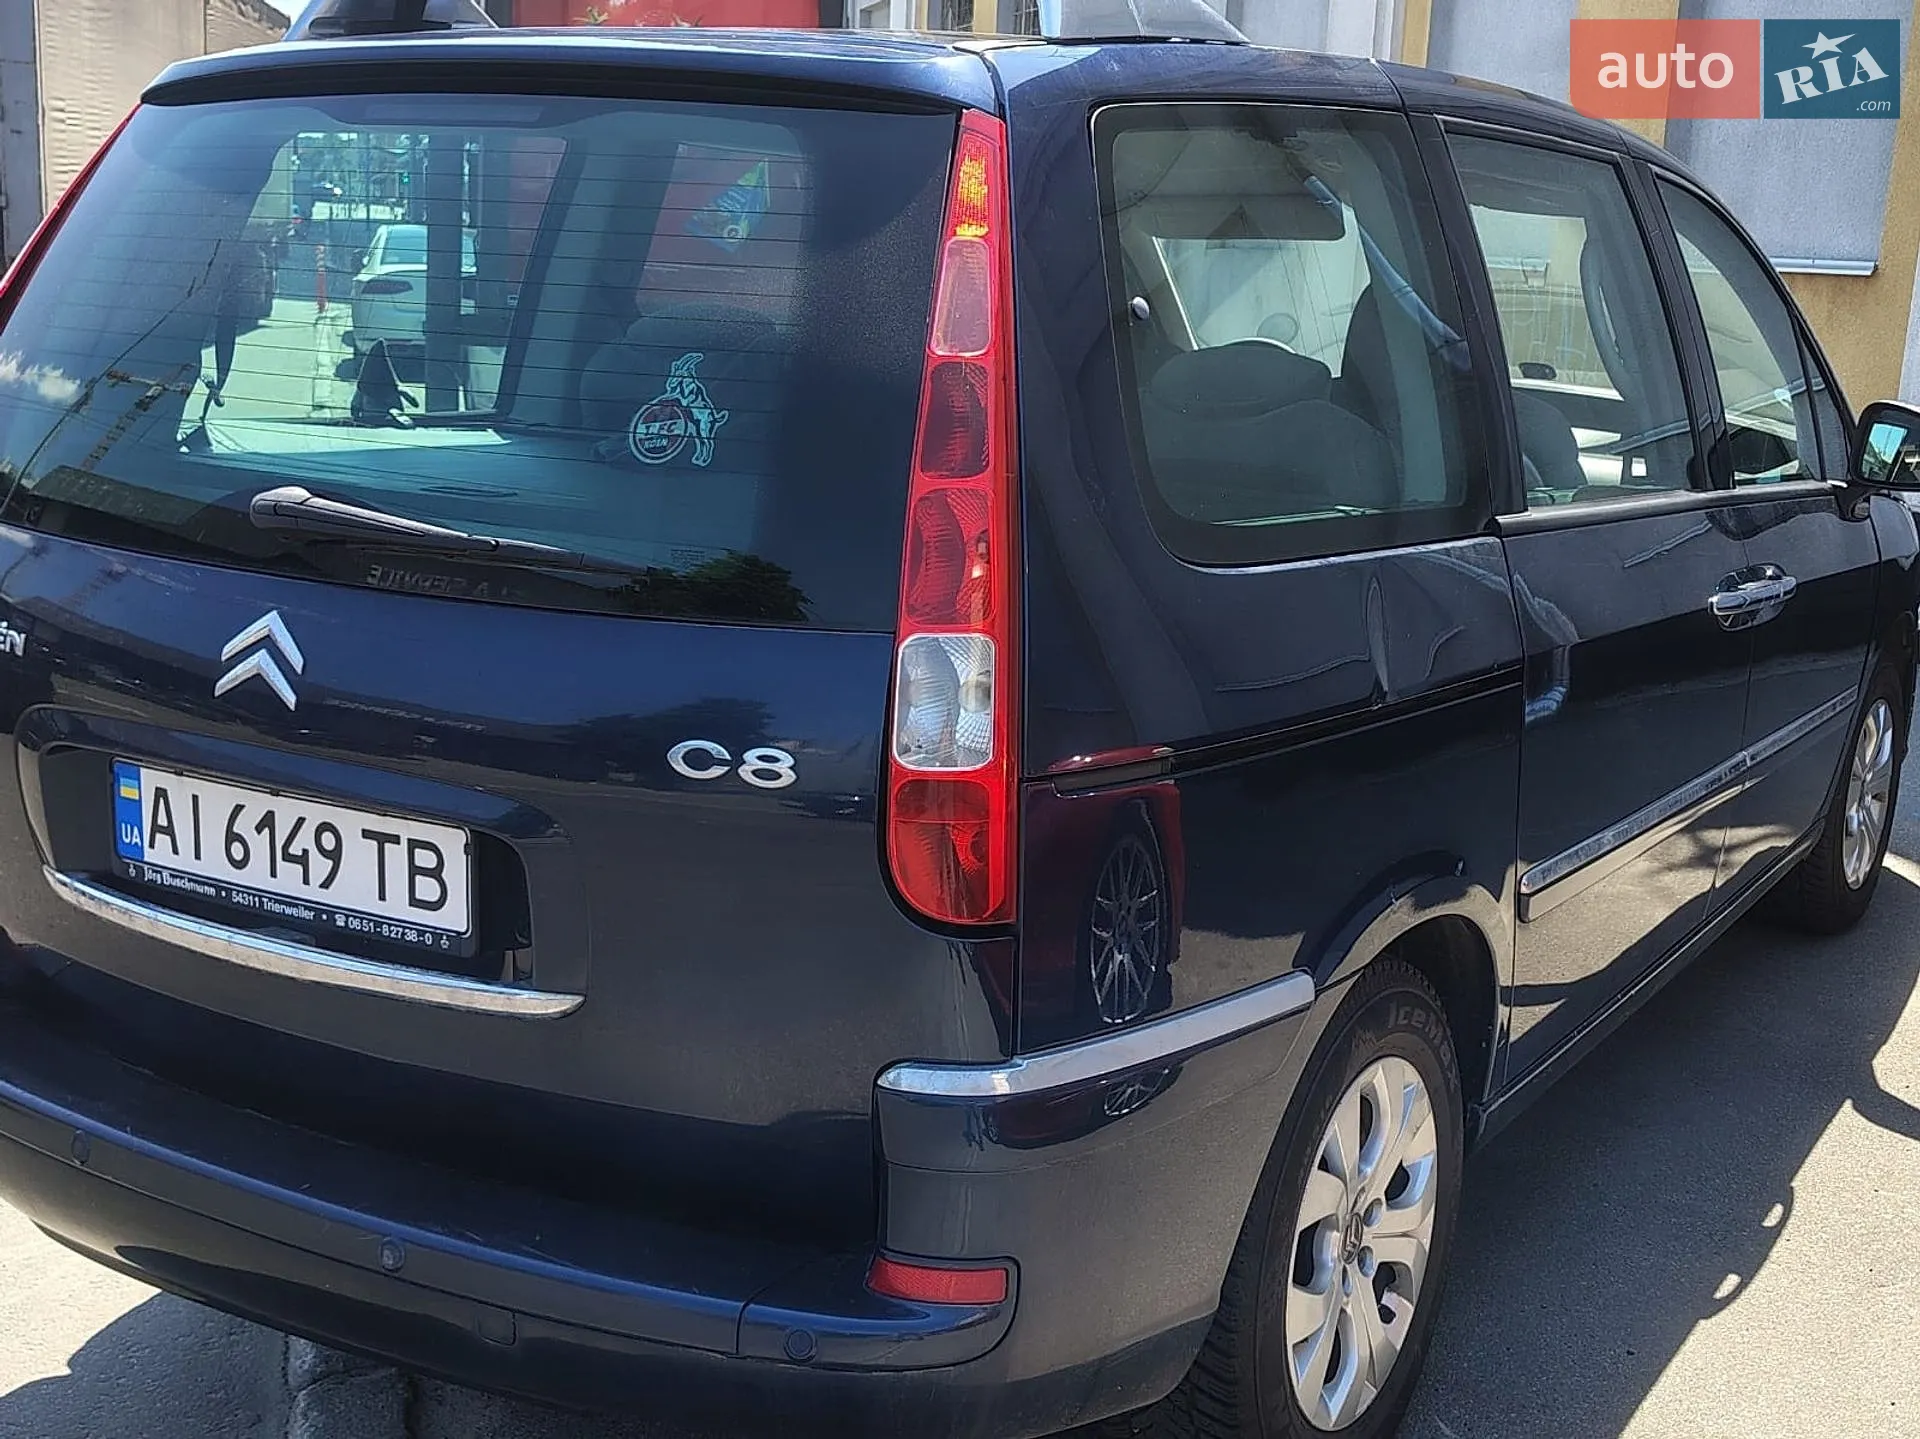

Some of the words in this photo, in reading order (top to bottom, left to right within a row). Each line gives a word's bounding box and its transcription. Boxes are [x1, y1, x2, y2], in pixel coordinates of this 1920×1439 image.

[666, 739, 798, 789] C8
[121, 823, 142, 846] UA
[148, 786, 202, 861] AI
[224, 803, 343, 890] 6149
[361, 828, 448, 911] TB
[231, 891, 259, 908] 54311
[261, 897, 315, 920] Trierweiler
[347, 916, 433, 945] 0651-82738-0
